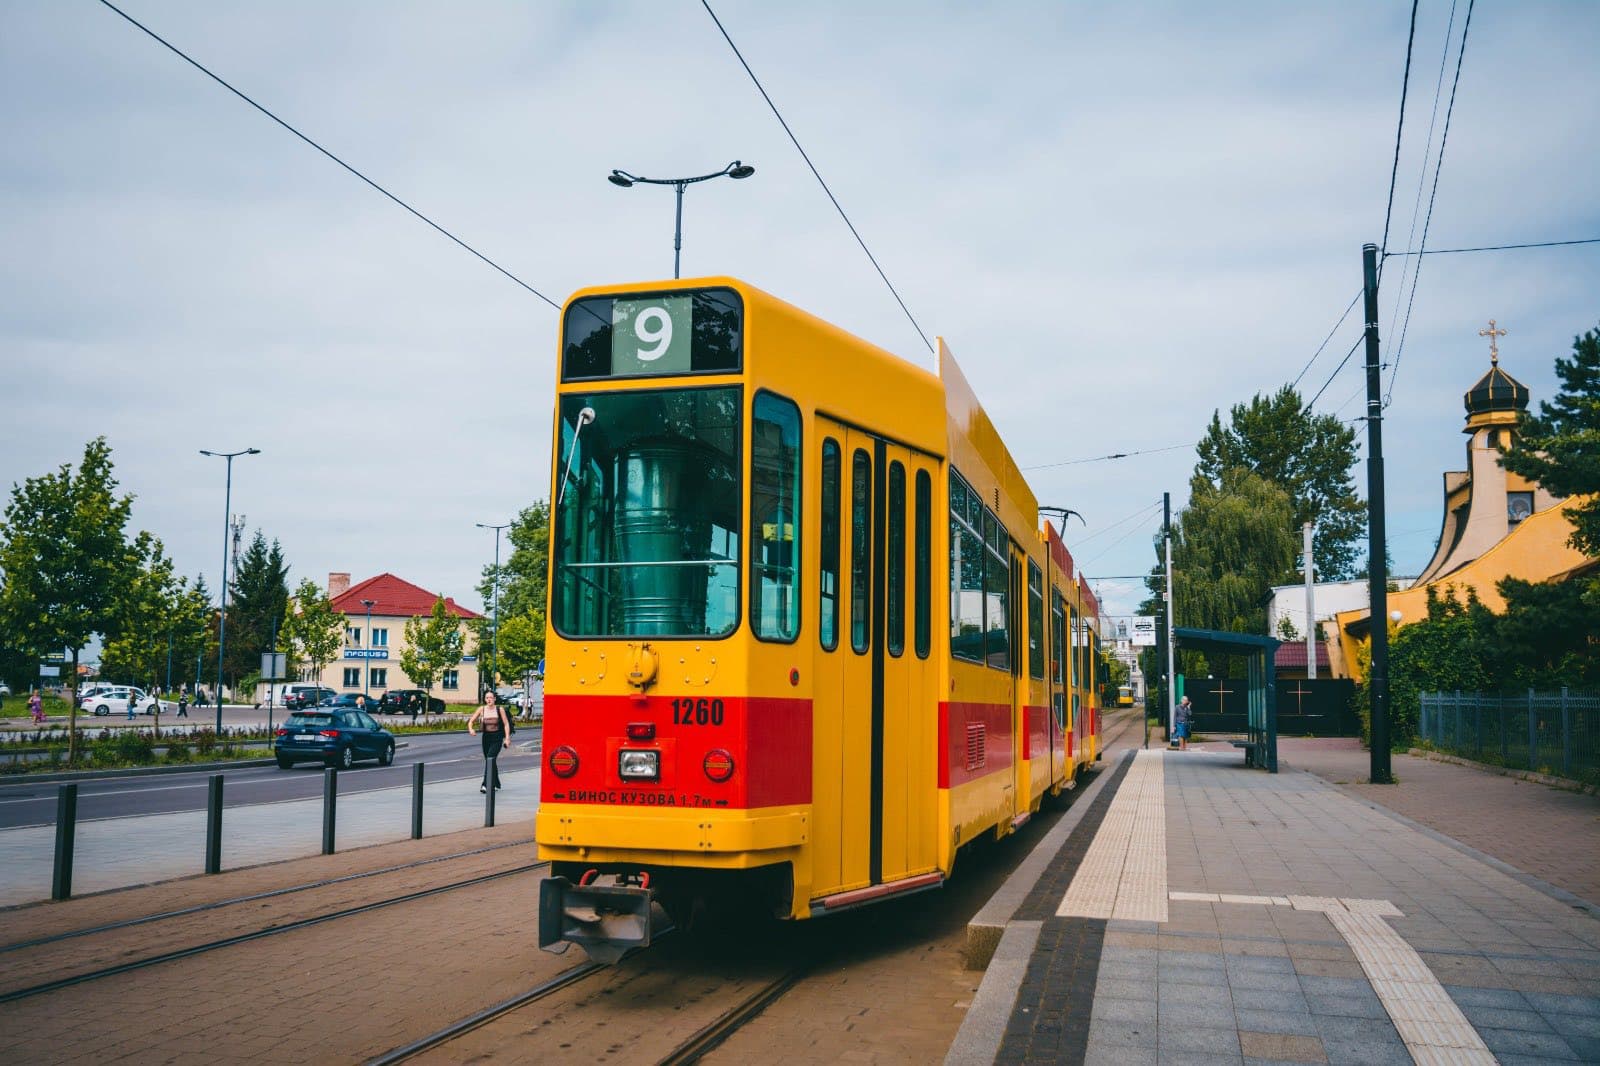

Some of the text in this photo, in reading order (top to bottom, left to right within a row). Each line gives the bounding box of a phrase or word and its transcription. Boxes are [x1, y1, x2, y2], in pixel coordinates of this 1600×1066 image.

[634, 306, 673, 361] 9
[672, 698, 724, 726] 1260
[568, 790, 617, 803] ВИНОС
[620, 792, 676, 805] КУЗОВА
